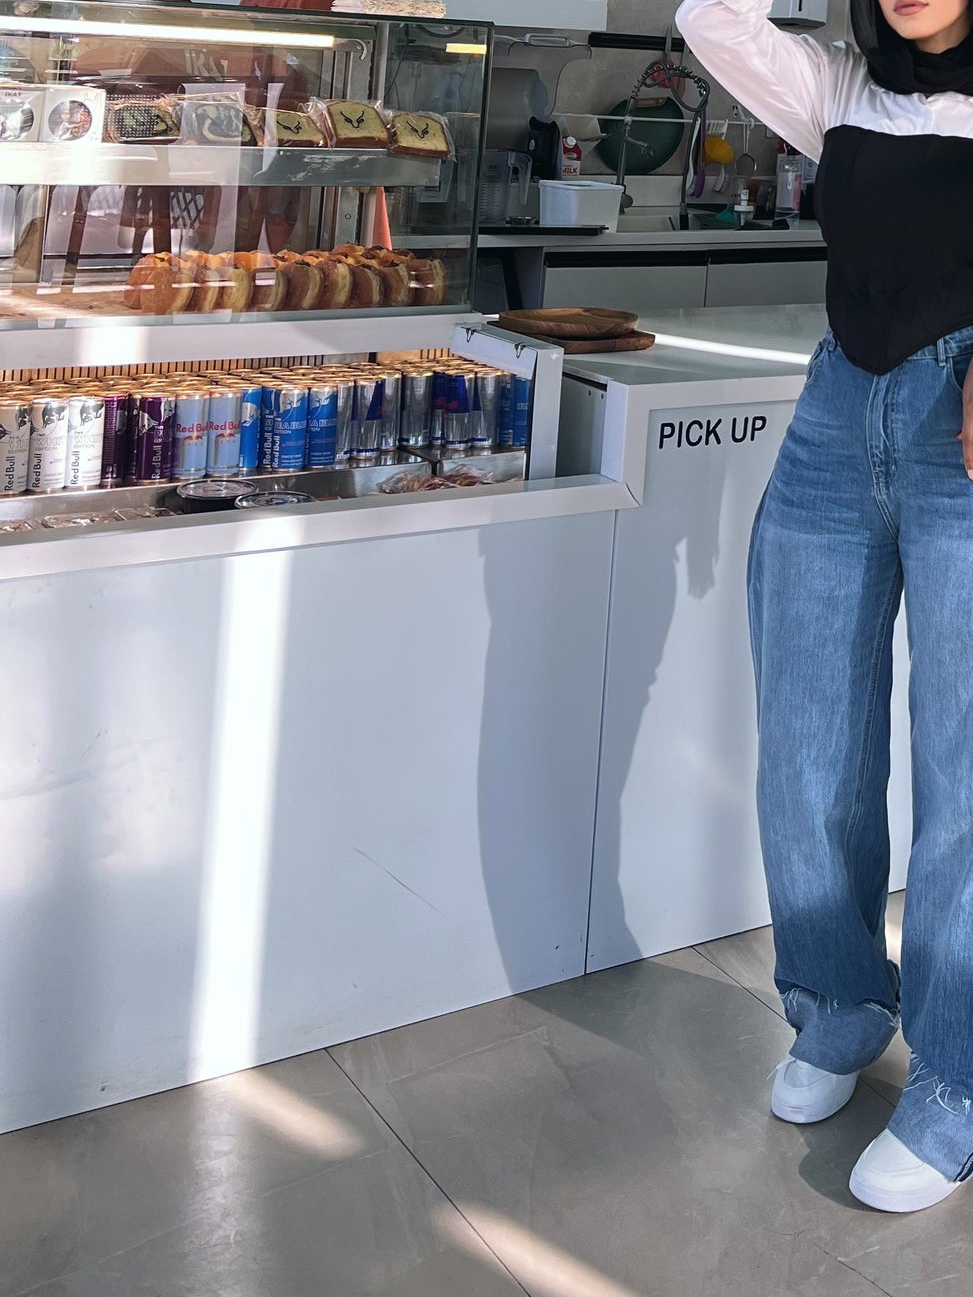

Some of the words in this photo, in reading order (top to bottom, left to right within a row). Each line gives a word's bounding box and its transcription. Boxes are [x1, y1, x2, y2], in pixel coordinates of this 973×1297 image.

[176, 423, 195, 433] Red
[208, 420, 227, 430] Red
[659, 418, 722, 449] PICK
[731, 415, 767, 443] UP
[263, 433, 272, 449] Bull
[71, 450, 80, 468] Bull
[152, 445, 162, 462] Bull
[263, 449, 272, 465] Red
[5, 455, 16, 474] Bull
[33, 453, 42, 472] Bull
[151, 462, 161, 479] Red
[4, 474, 15, 492] Red
[32, 471, 41, 488] Red
[70, 468, 80, 485] Red
